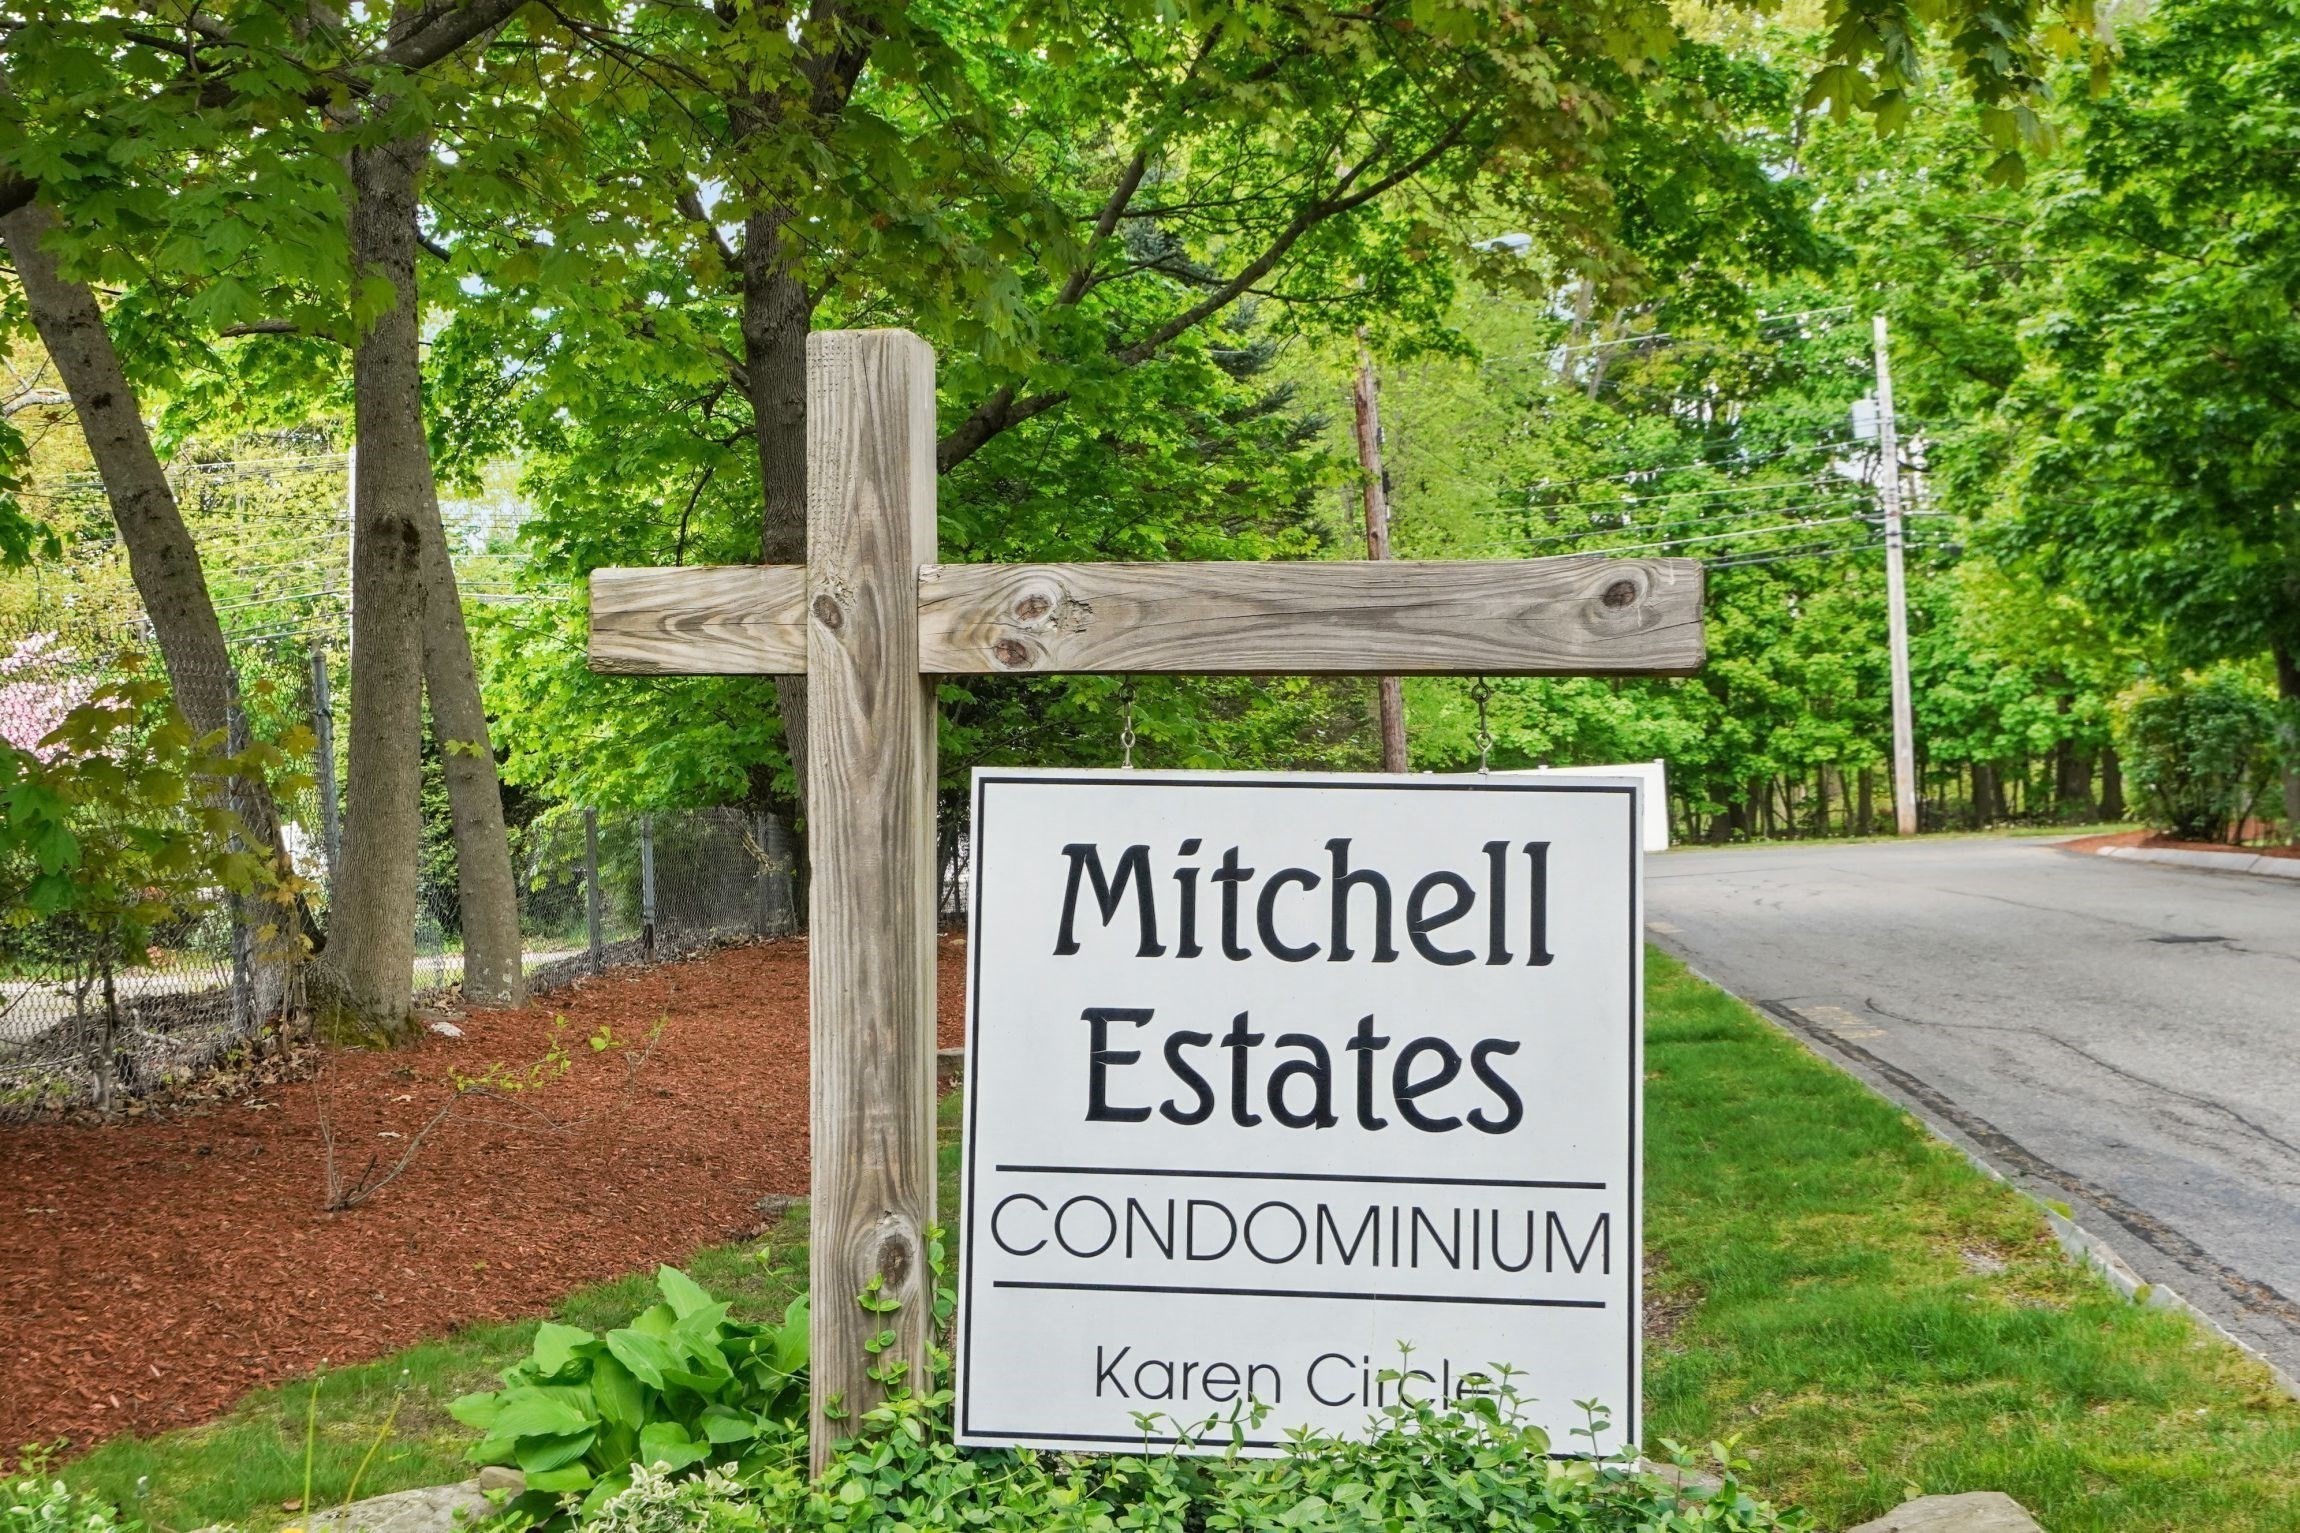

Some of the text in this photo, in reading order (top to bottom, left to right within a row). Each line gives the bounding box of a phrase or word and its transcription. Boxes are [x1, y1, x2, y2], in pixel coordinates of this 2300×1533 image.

[1053, 838, 1554, 968] Mitchell
[1081, 1007, 1524, 1133] Estates
[990, 1193, 1610, 1276] CONDOMINIUM
[1096, 1345, 1494, 1412] Karen Circle
